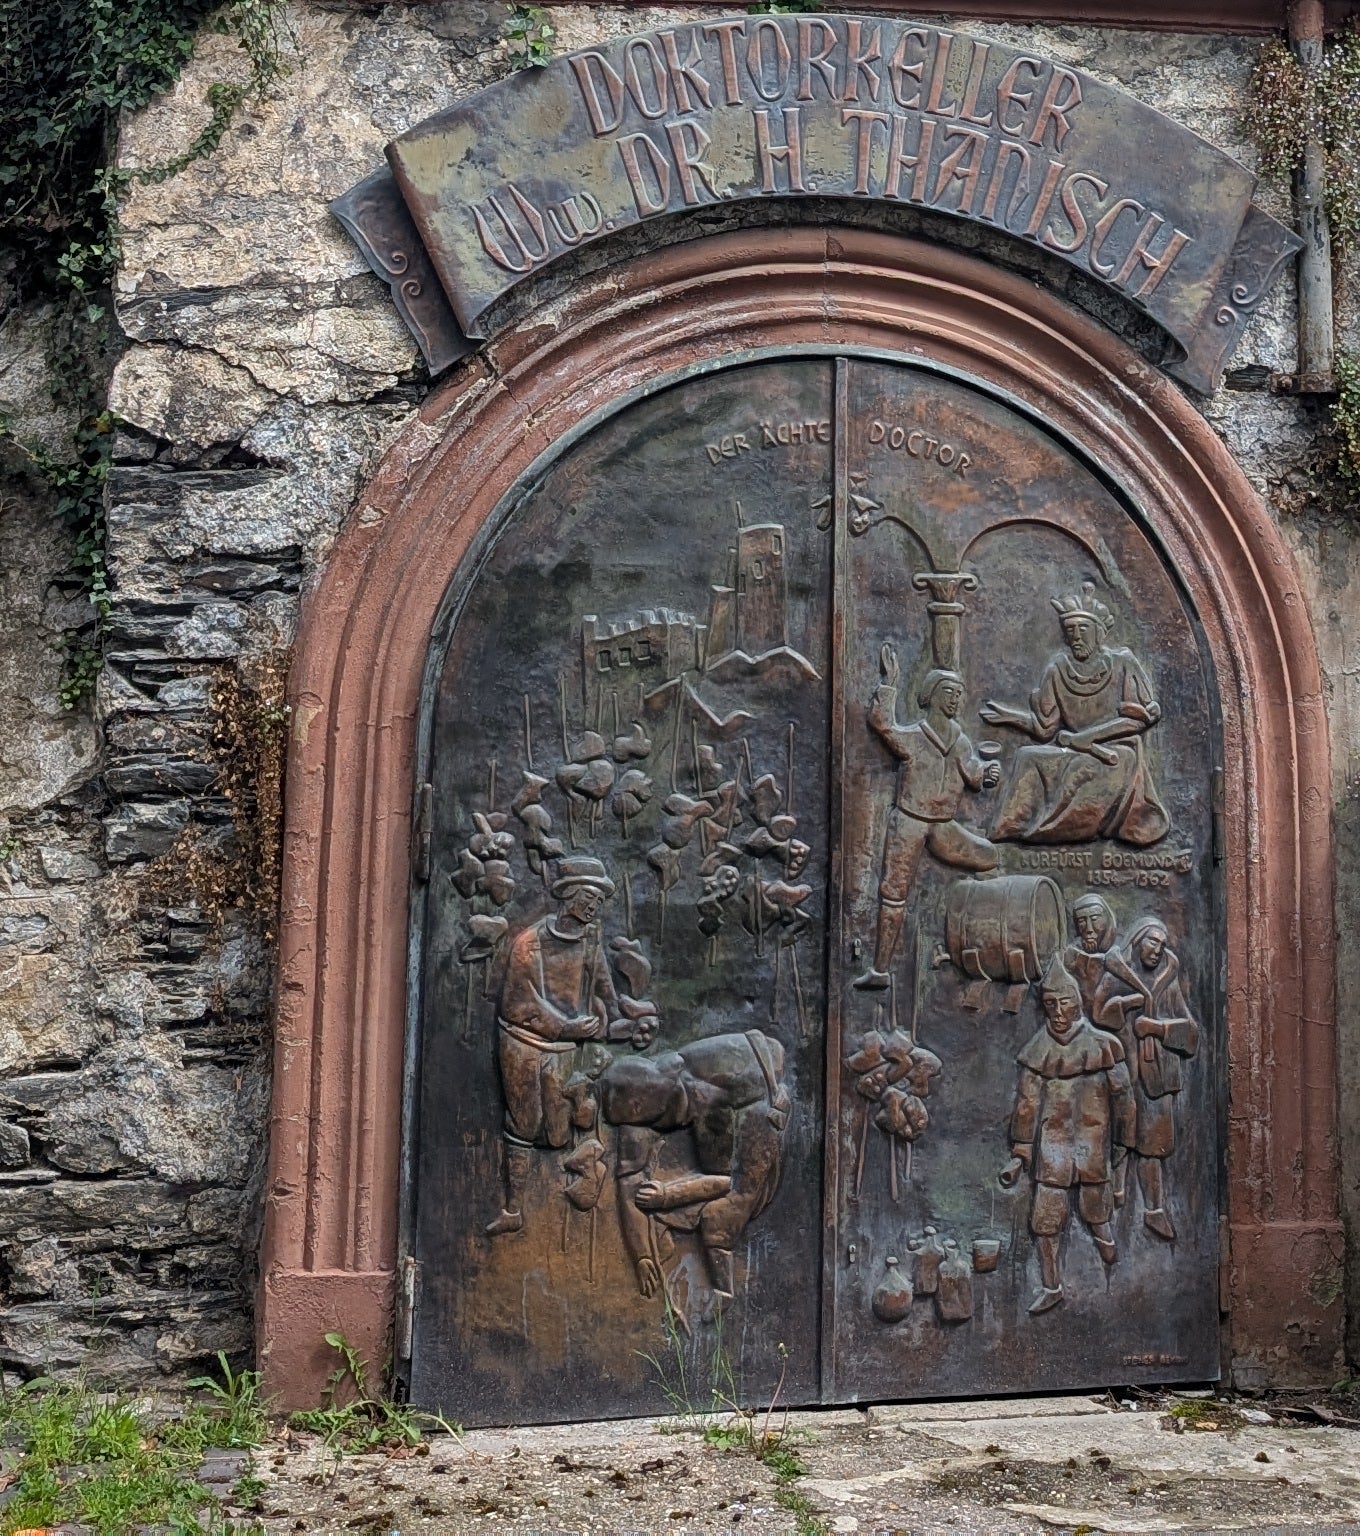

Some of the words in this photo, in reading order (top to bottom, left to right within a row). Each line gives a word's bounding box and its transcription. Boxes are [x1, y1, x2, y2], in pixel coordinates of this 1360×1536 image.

[568, 17, 1082, 154] DOKTORKELLER
[615, 119, 734, 216] DR.
[752, 107, 818, 195] H.
[841, 107, 1193, 302] THANISCH
[704, 432, 751, 466] DER
[868, 420, 971, 478] DOCTOR
